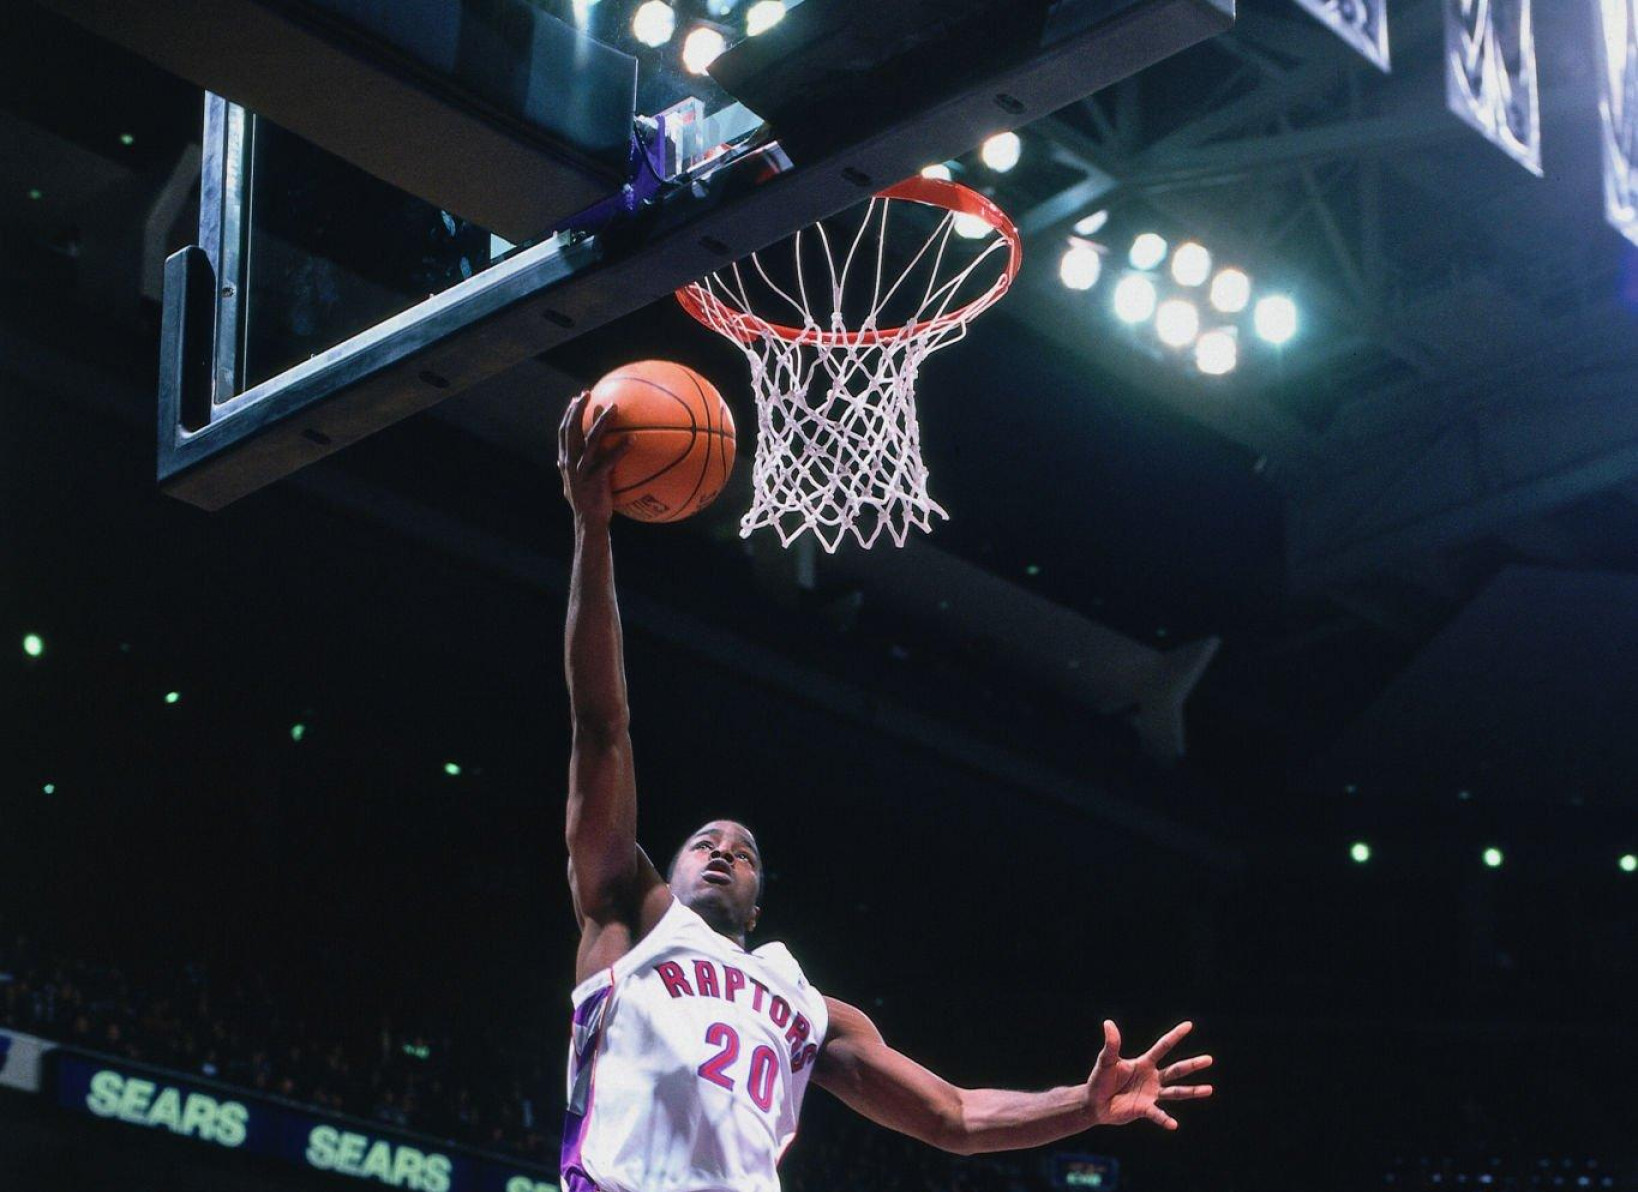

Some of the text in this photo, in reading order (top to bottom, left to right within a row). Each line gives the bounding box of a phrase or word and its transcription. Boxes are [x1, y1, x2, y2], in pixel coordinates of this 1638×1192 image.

[653, 959, 817, 1074] RAPTORS
[86, 1070, 249, 1147] SEARS
[697, 1021, 780, 1114] 20
